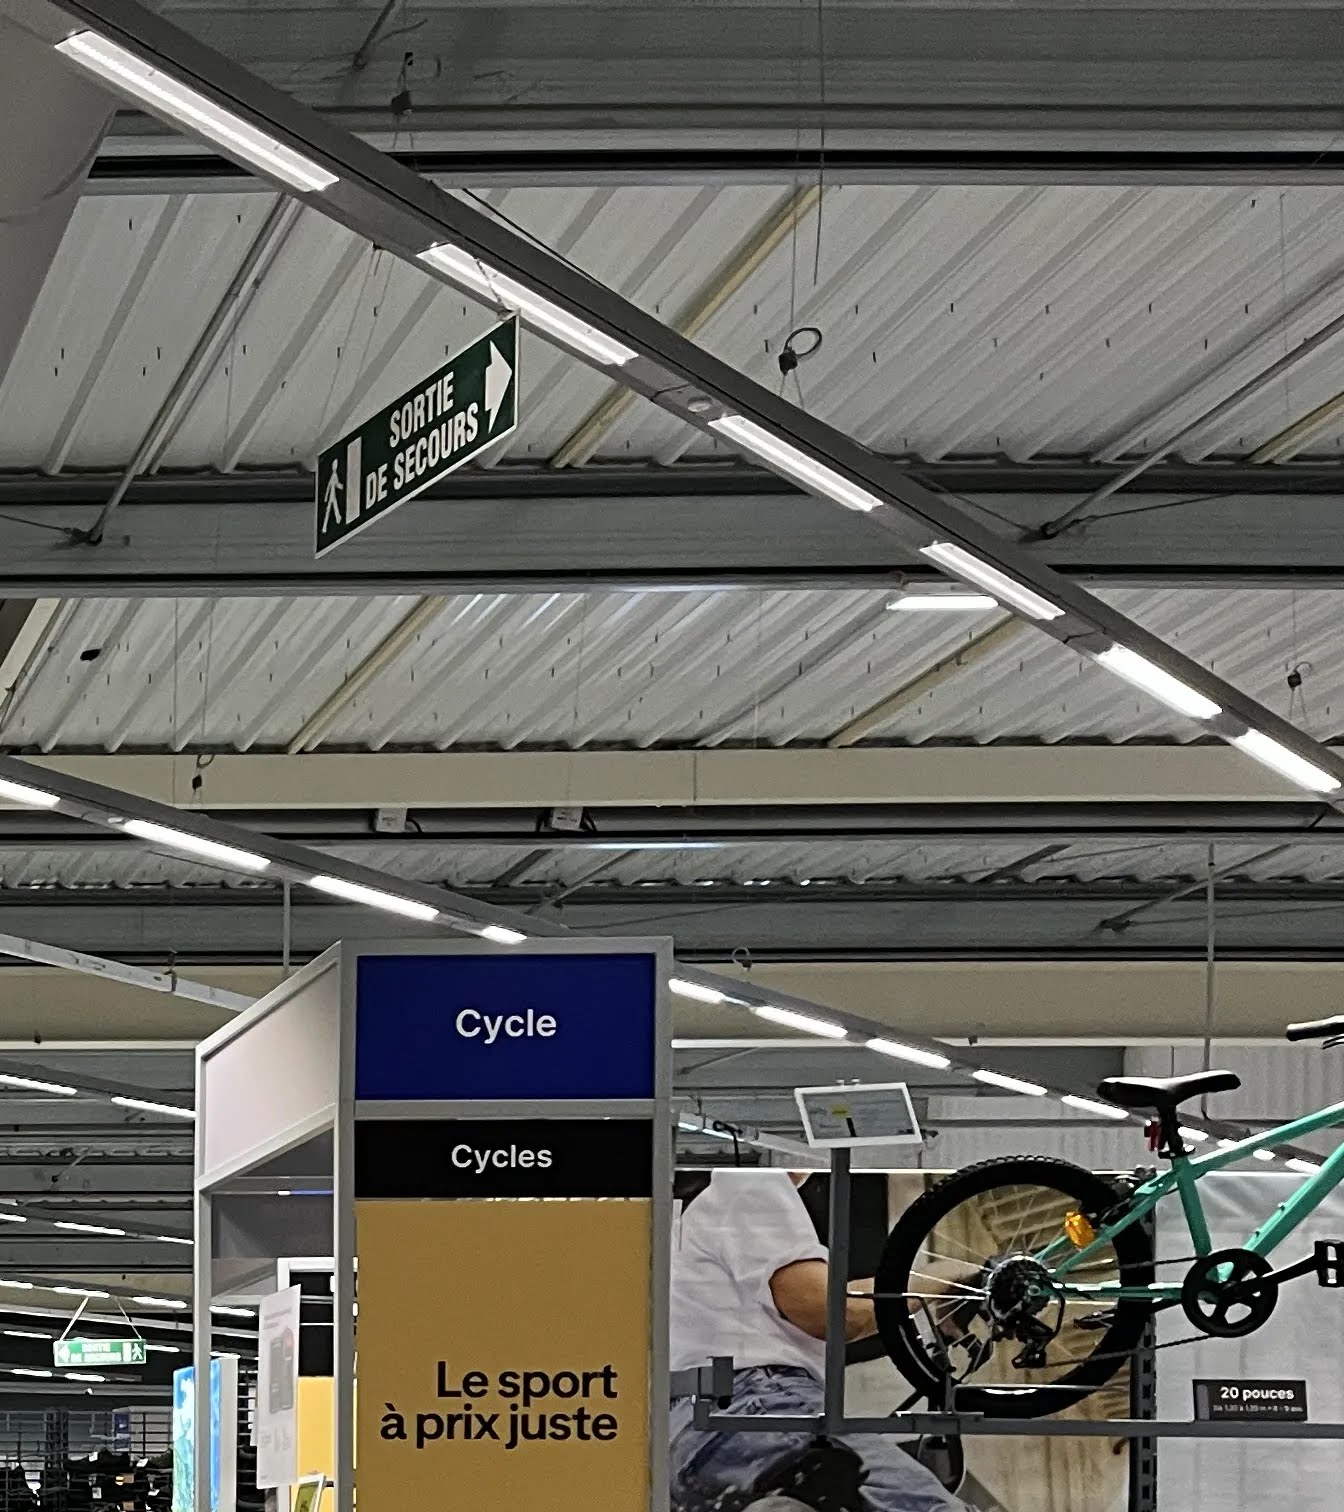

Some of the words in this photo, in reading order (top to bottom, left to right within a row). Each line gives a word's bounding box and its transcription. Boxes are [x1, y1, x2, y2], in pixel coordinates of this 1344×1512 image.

[389, 371, 454, 449] SORTIE
[365, 463, 389, 510] DE
[393, 402, 479, 491] SECOURS
[456, 1008, 557, 1045] Cycle
[451, 1144, 553, 1174] Cycles
[437, 1360, 489, 1399] Le
[497, 1363, 618, 1401] sport
[1219, 1386, 1239, 1399] 20
[1242, 1387, 1295, 1402] pouces
[380, 1403, 408, 1440] à
[416, 1403, 500, 1450] prix
[504, 1404, 618, 1450] juste
